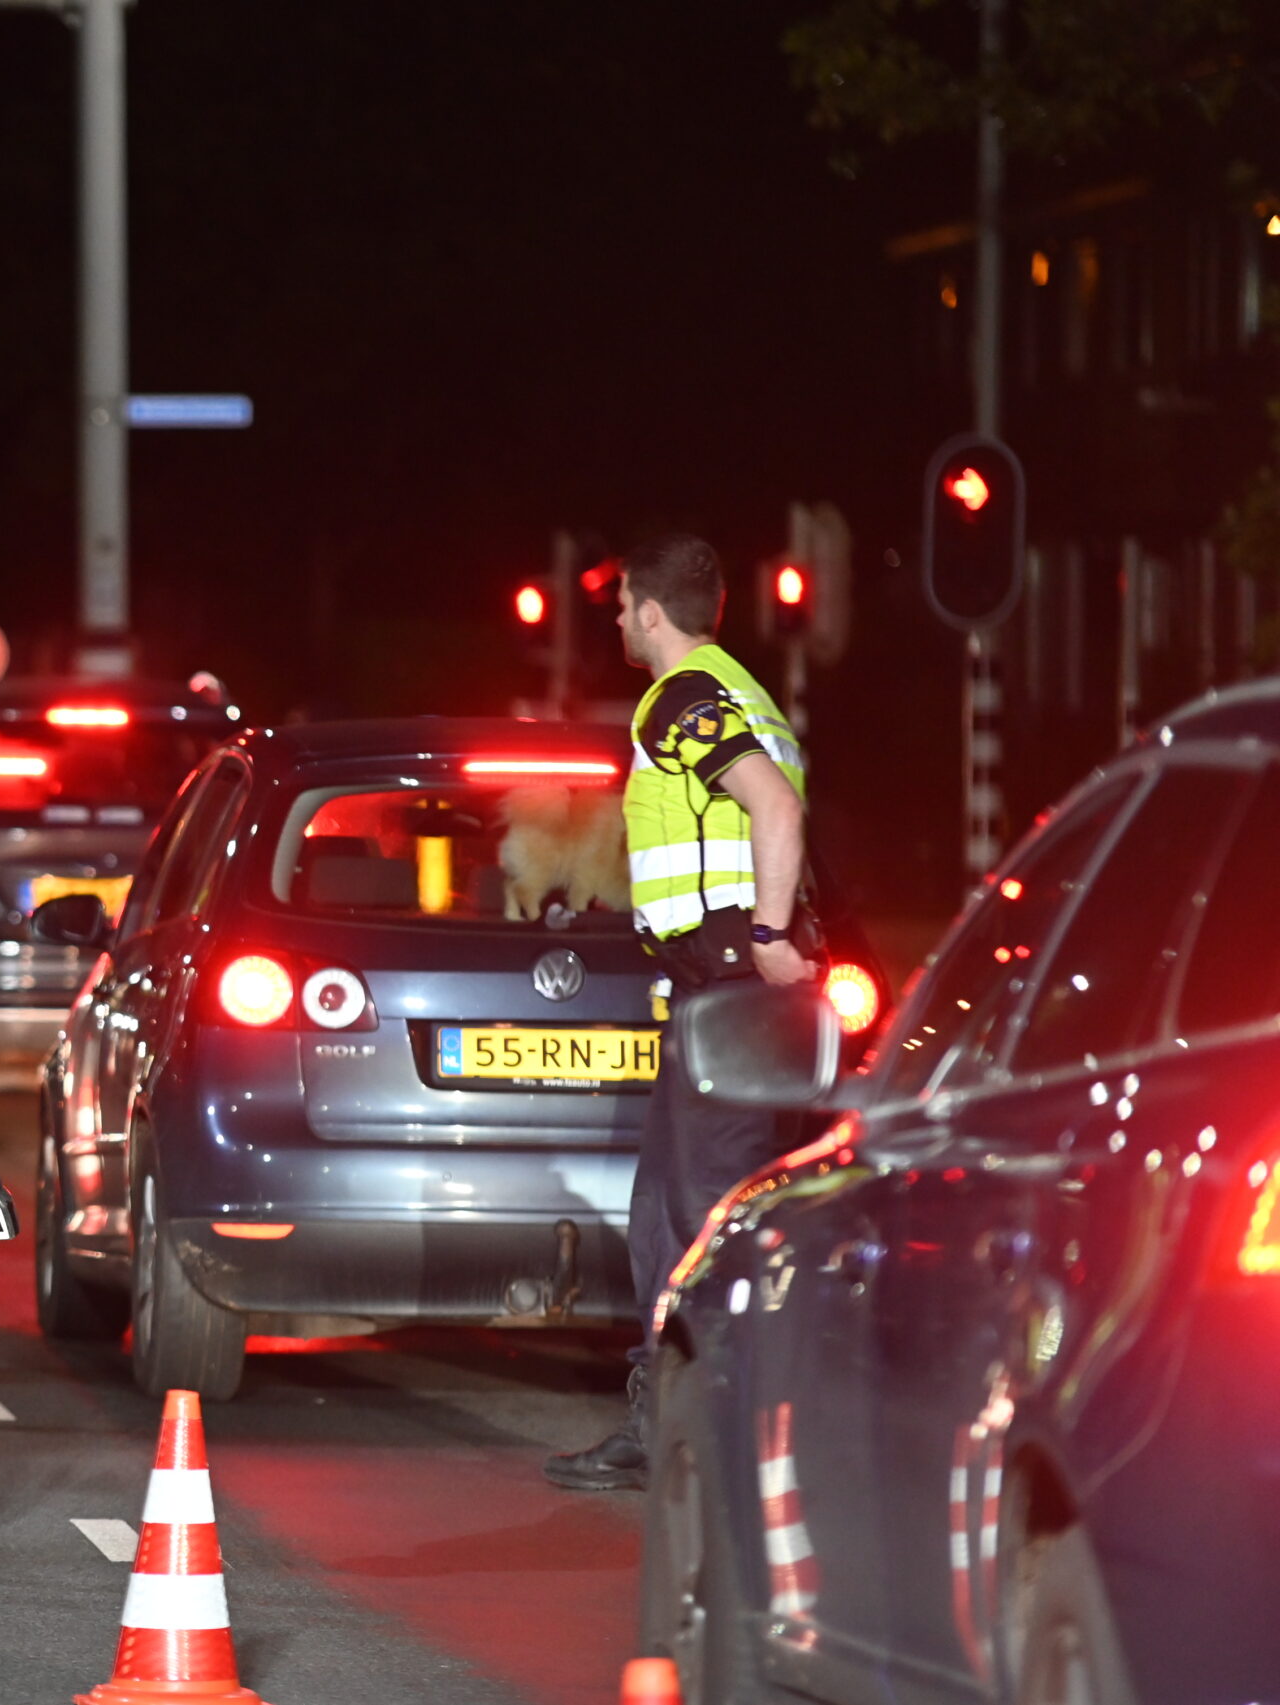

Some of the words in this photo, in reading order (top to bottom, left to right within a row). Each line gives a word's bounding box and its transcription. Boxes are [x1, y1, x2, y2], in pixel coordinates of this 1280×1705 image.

[315, 1045, 376, 1058] GOLF
[475, 1037, 655, 1070] 55-RN-JH
[443, 1055, 460, 1067] NL
